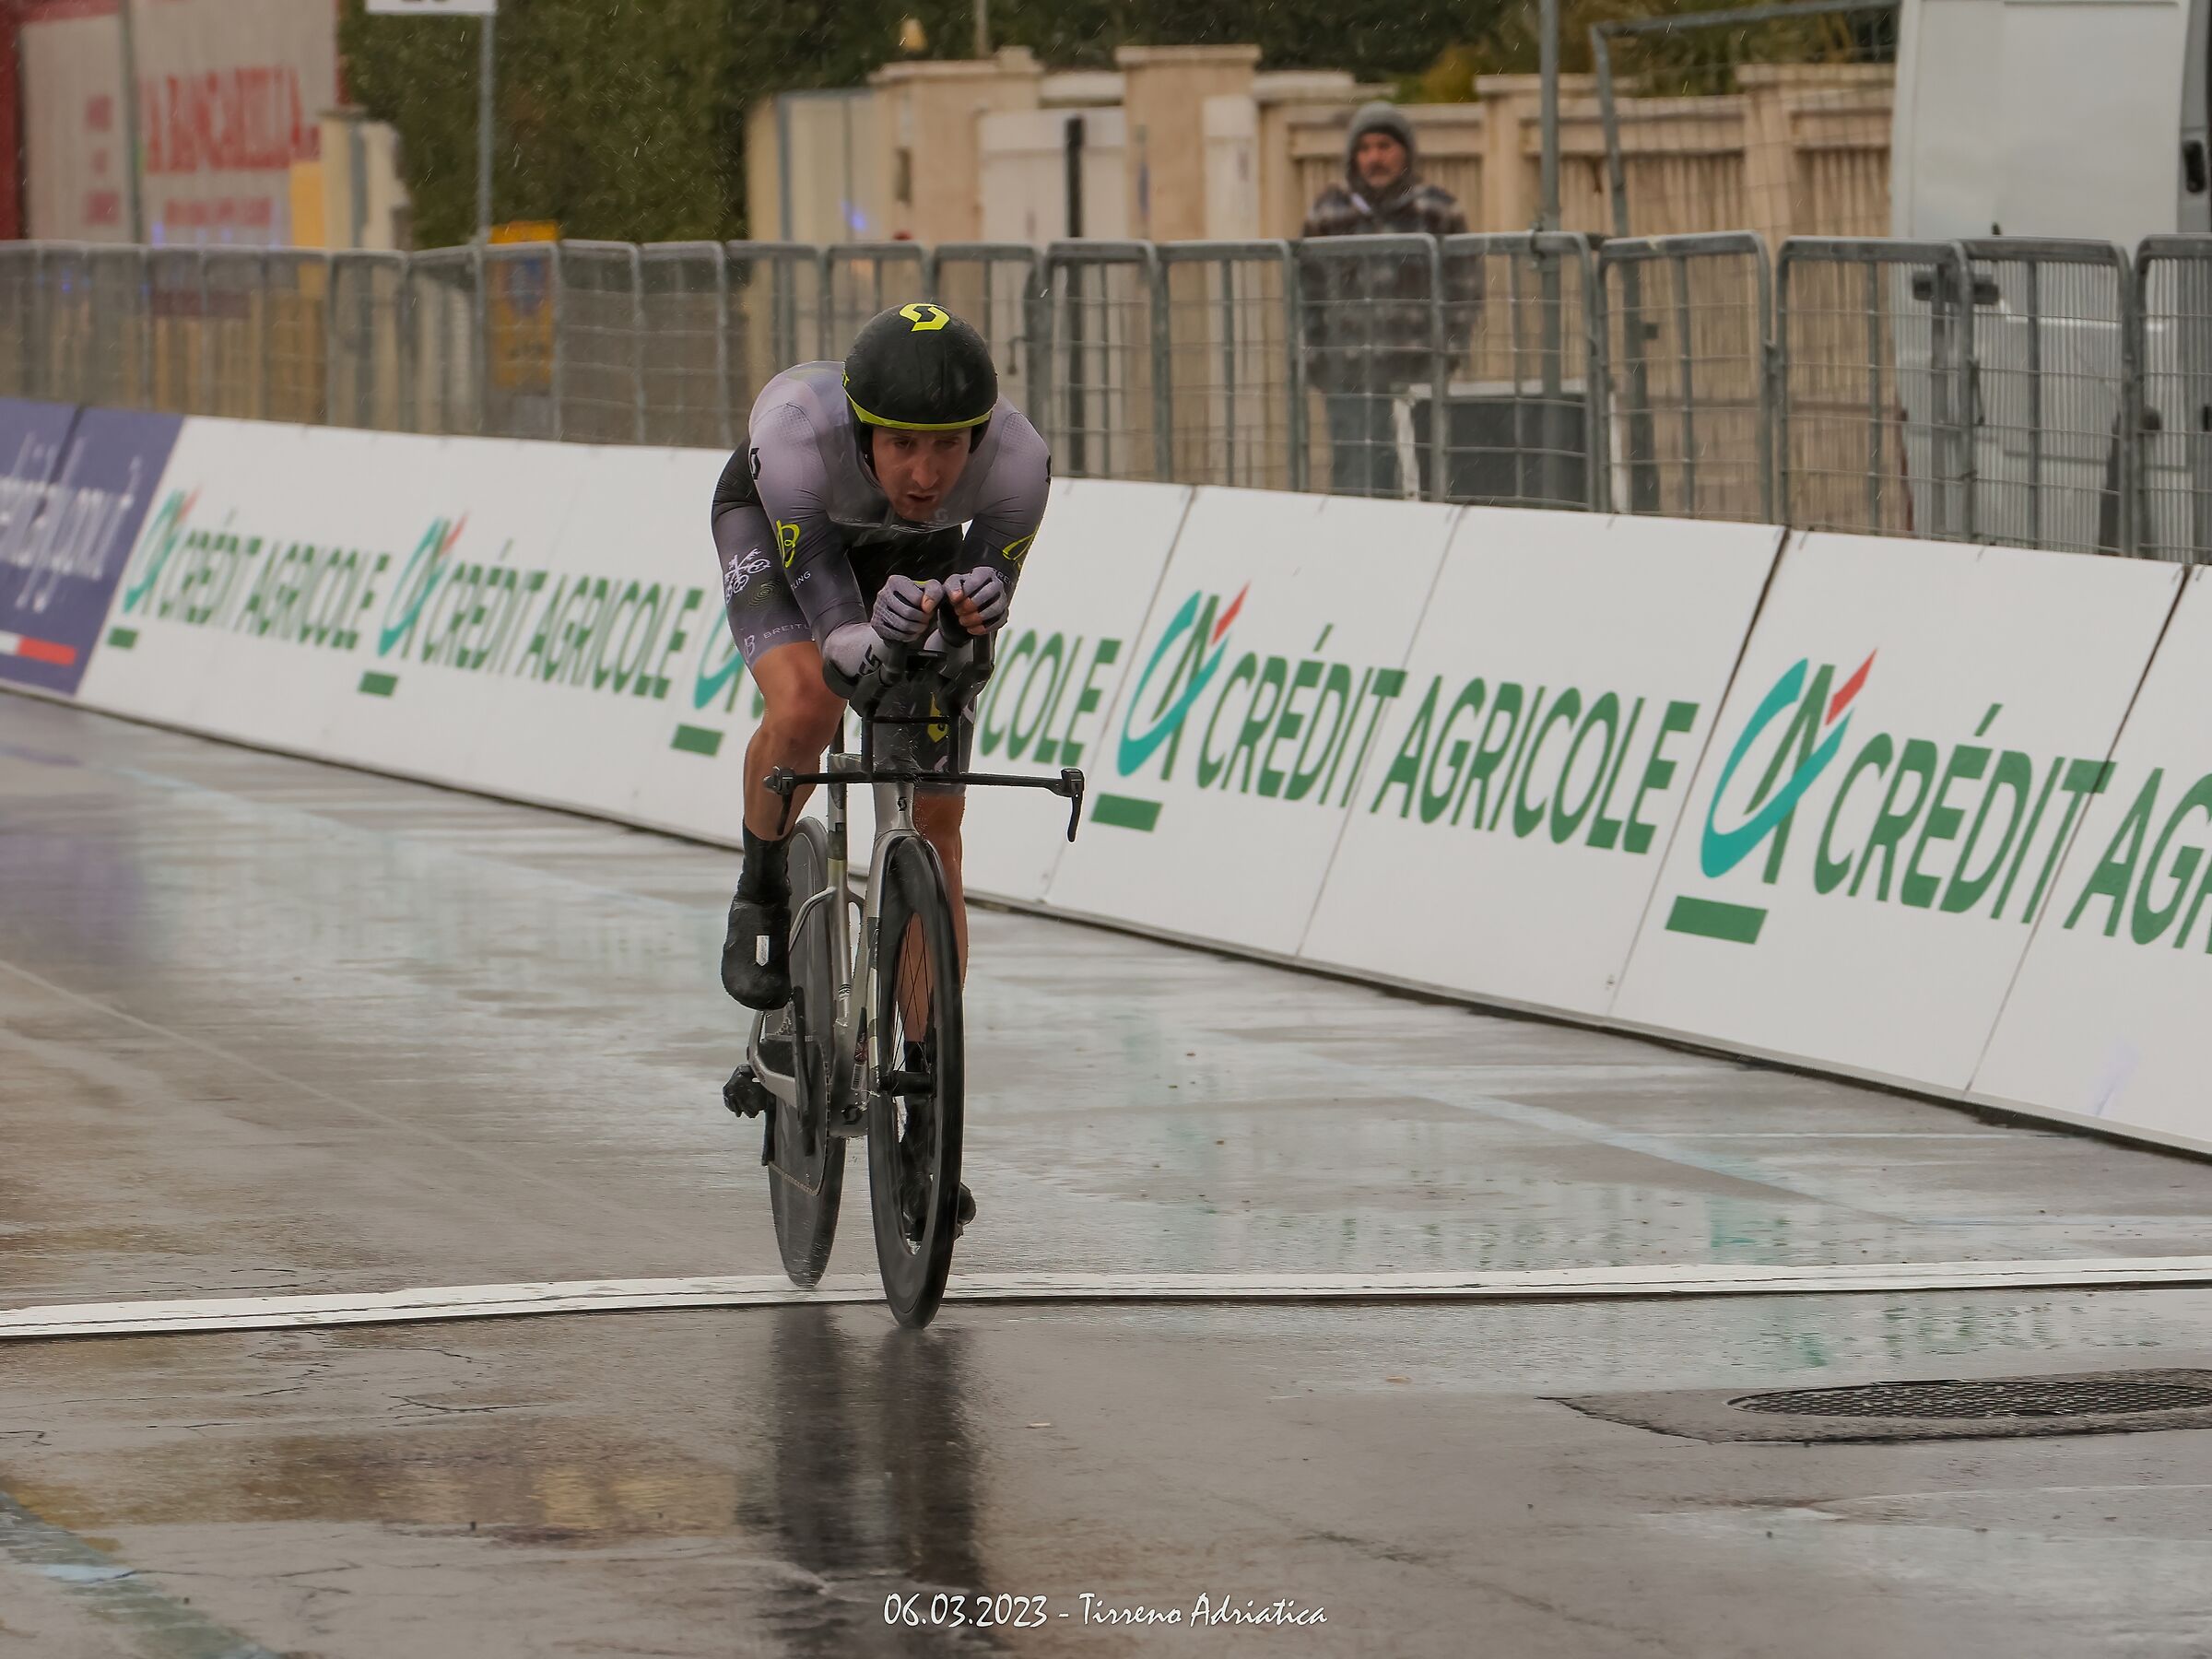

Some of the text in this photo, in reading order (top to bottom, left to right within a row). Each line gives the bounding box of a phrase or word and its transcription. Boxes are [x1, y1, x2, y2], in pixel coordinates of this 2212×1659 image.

[233, 540, 390, 651] AGRICOLE
[421, 538, 547, 676] CRÉDIT
[515, 573, 703, 700] AGRICOLE
[763, 622, 811, 639] BREITL
[972, 629, 1123, 767] ICOLE
[1196, 624, 1408, 808] CRÉDIT
[1370, 675, 1700, 854] AGRICOLE
[1813, 703, 2118, 925] CRÉDIT
